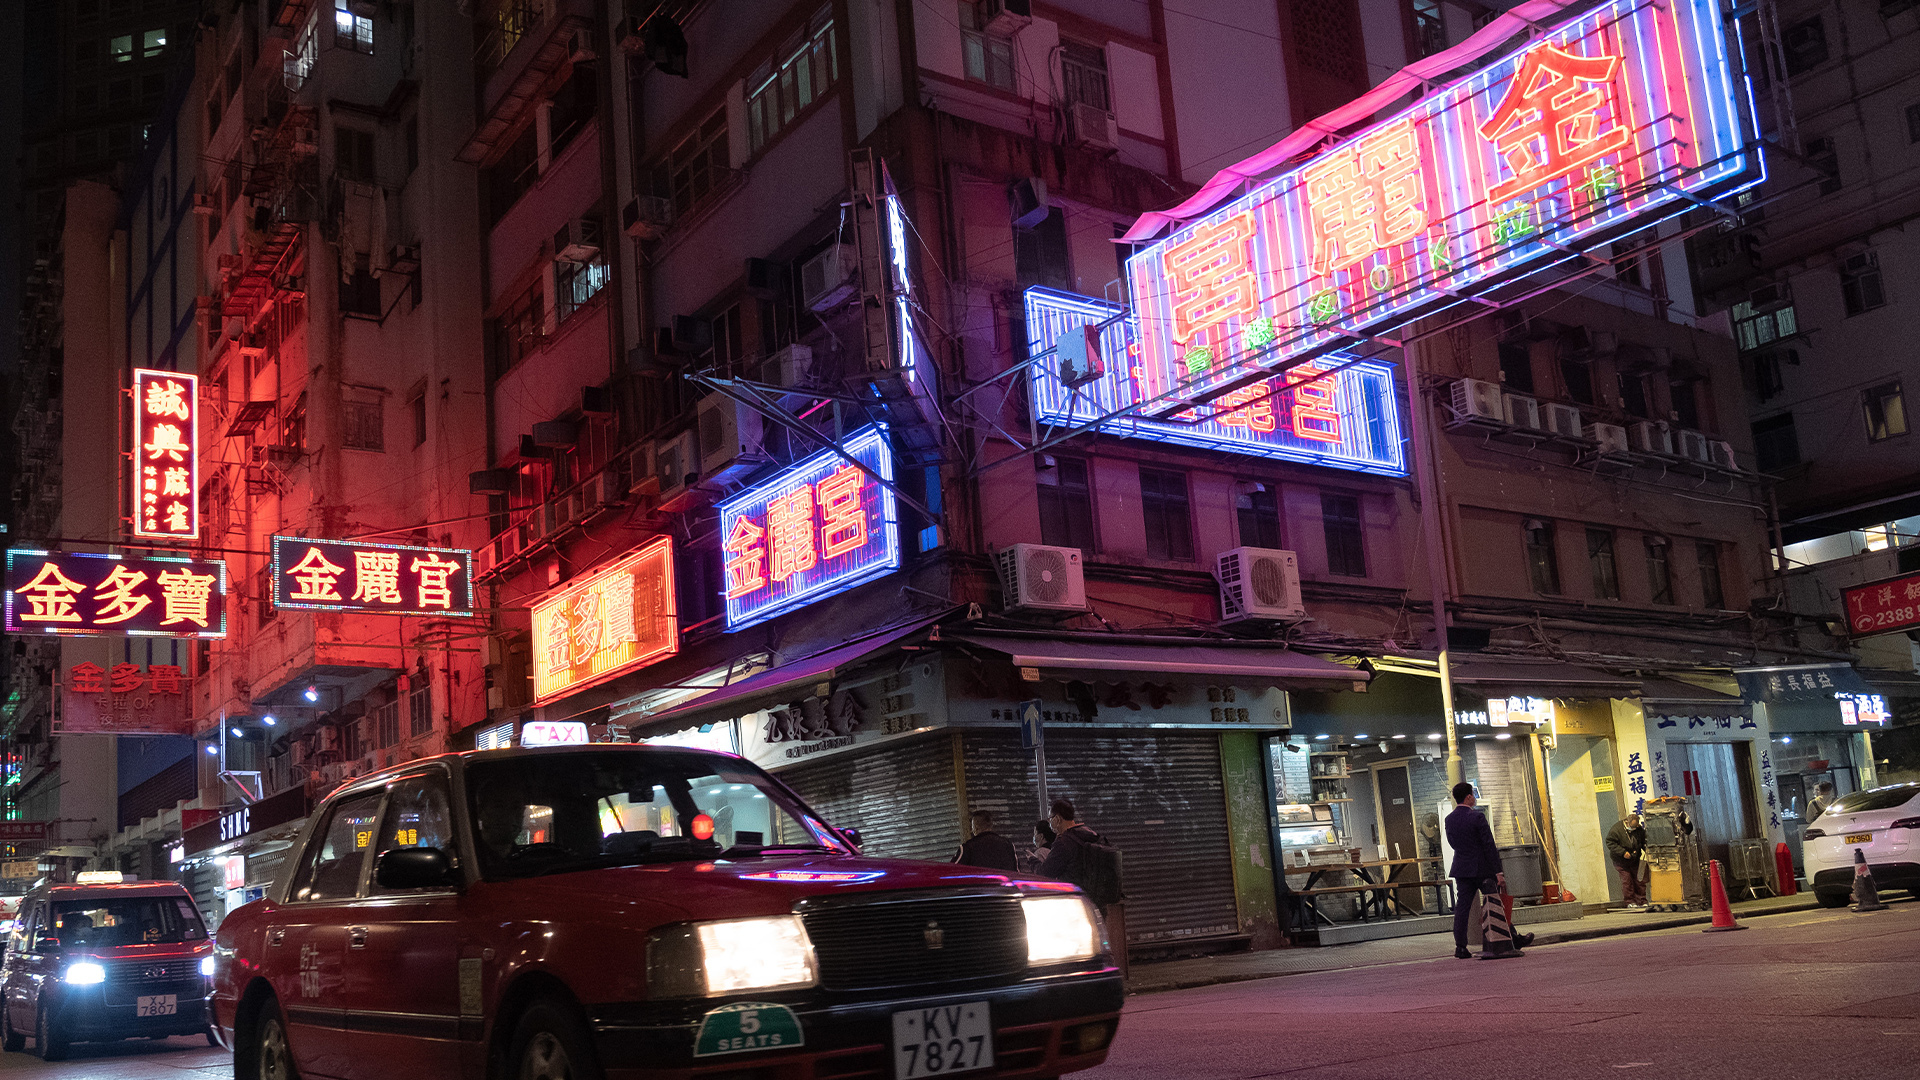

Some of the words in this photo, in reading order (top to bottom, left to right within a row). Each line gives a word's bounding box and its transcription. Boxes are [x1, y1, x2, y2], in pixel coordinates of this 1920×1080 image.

[1163, 39, 1632, 345] 金麗宮
[723, 465, 869, 600] 金麗宮
[16, 562, 216, 628] 金多寶
[286, 547, 460, 609] 金麗宮
[546, 572, 638, 676] 金多寶
[1876, 606, 1914, 626] 2388
[71, 661, 181, 694] 金多寶
[535, 726, 583, 742] TAXI
[141, 1004, 174, 1016] 7807
[150, 996, 166, 1006] XJ
[740, 1010, 761, 1034] 5
[922, 1006, 962, 1041] KV
[718, 1034, 783, 1051] SEATS
[903, 1035, 986, 1077] 7827
